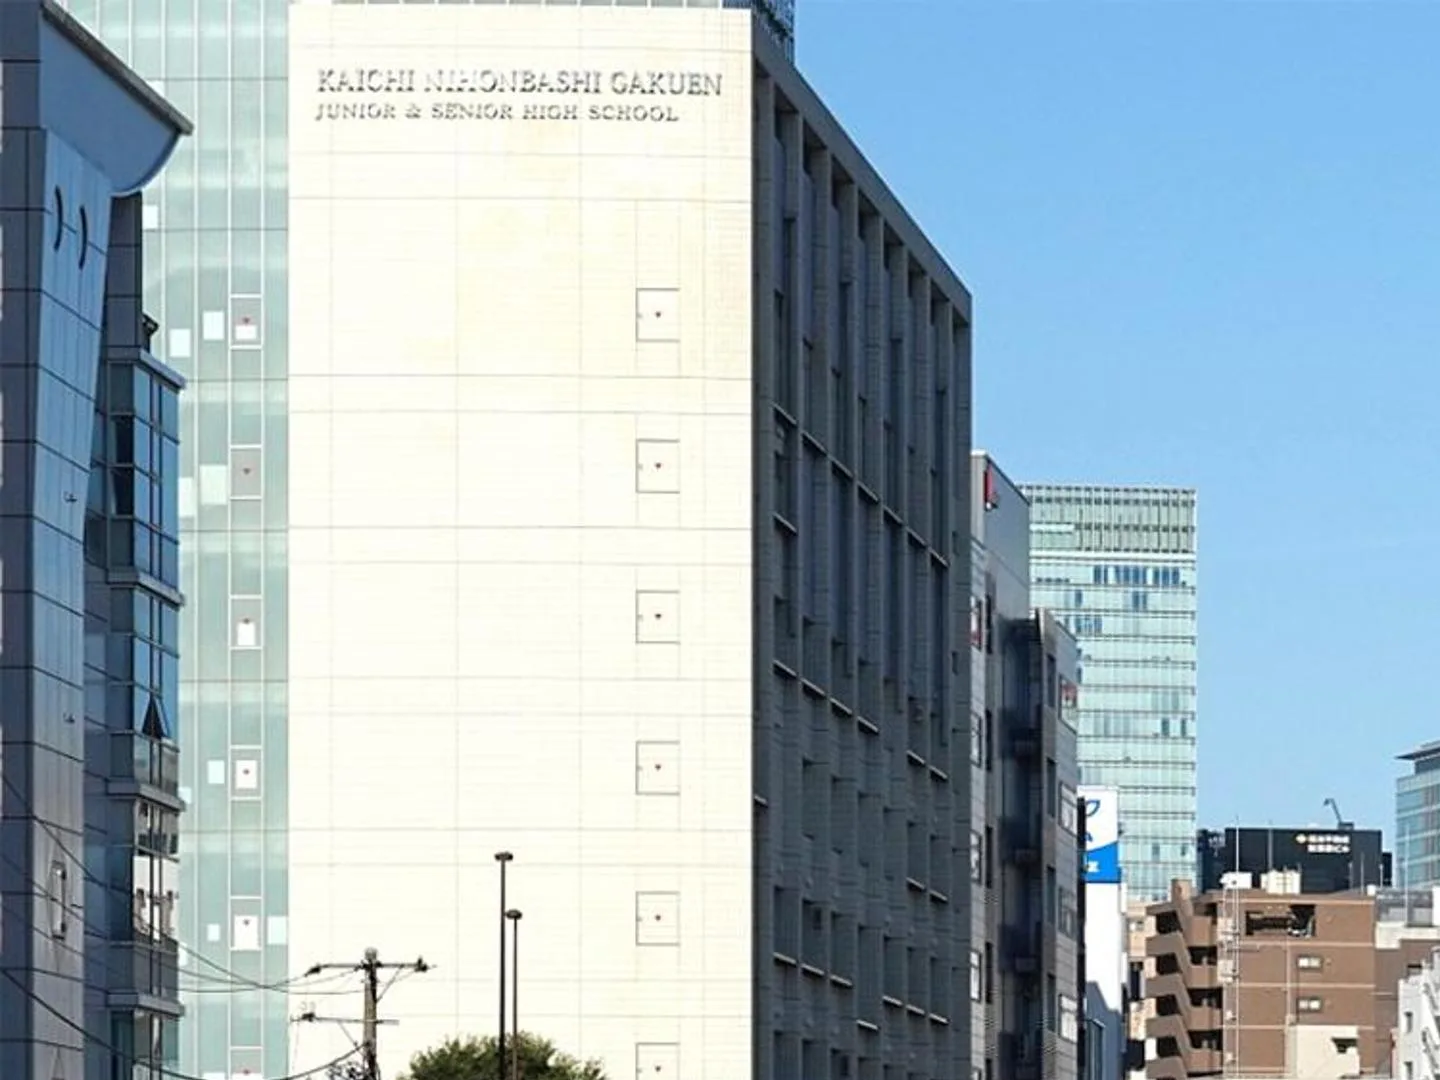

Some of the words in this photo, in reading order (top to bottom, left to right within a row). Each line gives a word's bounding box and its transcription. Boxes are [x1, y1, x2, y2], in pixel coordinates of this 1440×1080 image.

[317, 69, 414, 93] KAICHI
[424, 69, 602, 94] NIHONBASHI
[610, 71, 722, 96] GAKUEN
[315, 103, 396, 121] JUNIOR
[405, 106, 422, 120] &
[432, 103, 512, 120] SENIOR
[522, 105, 577, 120] HIGH
[588, 104, 679, 122] SCHOOL
